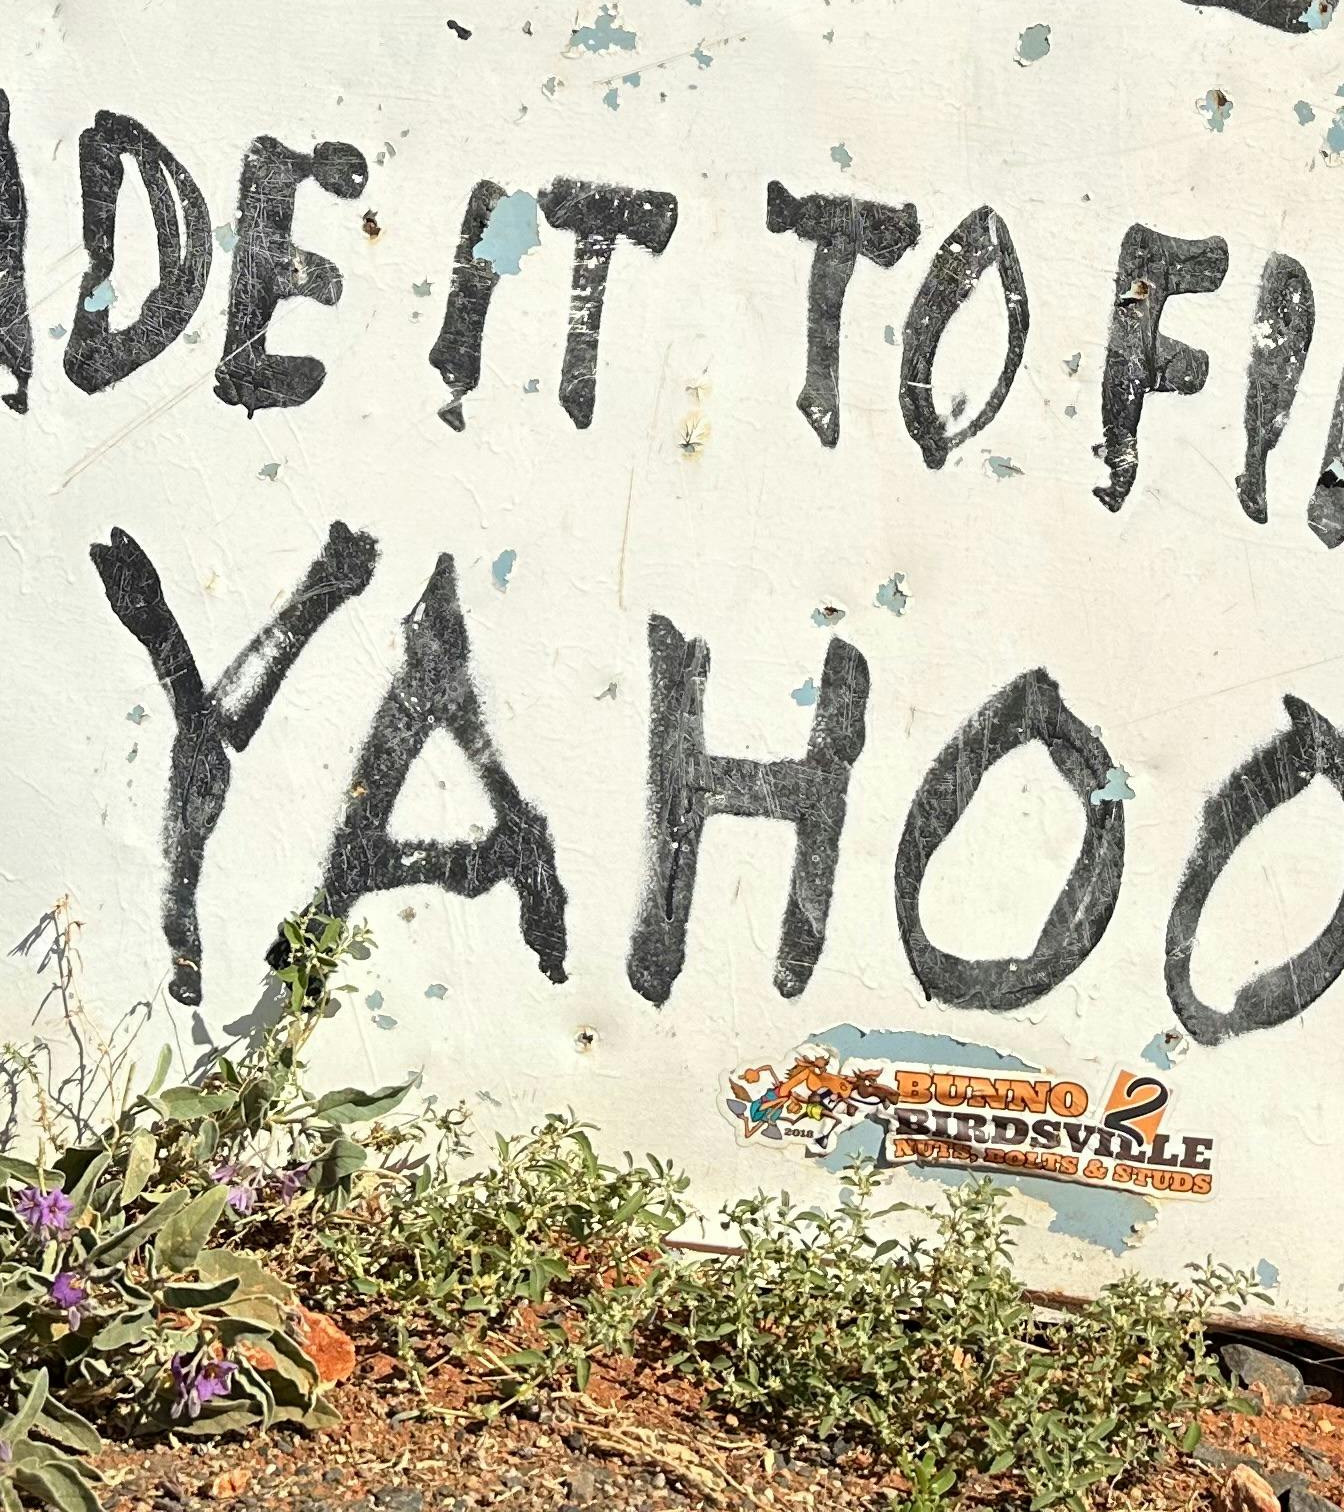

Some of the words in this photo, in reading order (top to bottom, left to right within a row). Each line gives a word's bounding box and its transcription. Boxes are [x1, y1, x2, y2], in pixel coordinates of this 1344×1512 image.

[429, 176, 677, 431] IT
[766, 179, 1030, 471] TO
[783, 1127, 815, 1140] 2018
[894, 1069, 1089, 1118] BUNNO
[1102, 1076, 1169, 1146] 2
[895, 1107, 1213, 1171] BIRDSVILLE
[894, 1137, 978, 1168] NUTS,
[983, 1146, 1079, 1177] BOLTS
[1082, 1157, 1109, 1180] &
[1112, 1163, 1213, 1196] STUDS
